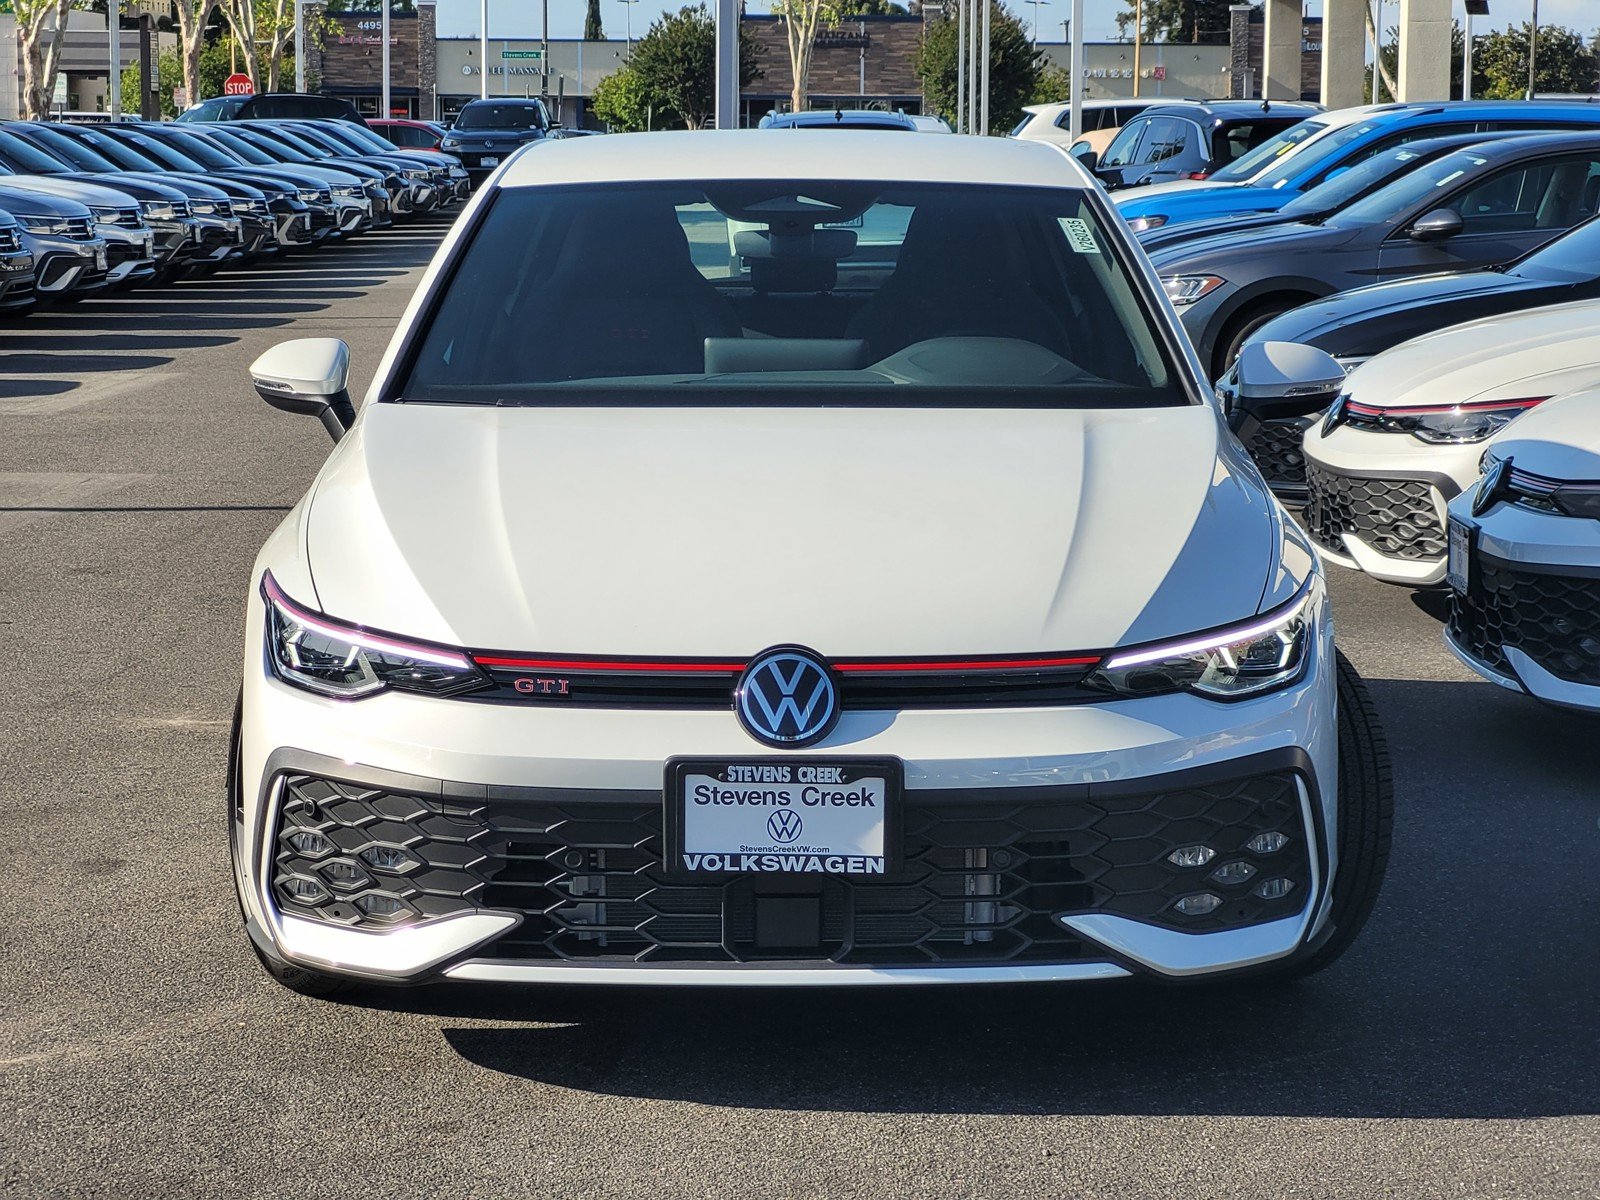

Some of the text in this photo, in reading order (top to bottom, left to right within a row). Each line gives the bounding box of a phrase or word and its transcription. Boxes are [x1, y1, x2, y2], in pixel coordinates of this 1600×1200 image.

[357, 21, 382, 30] 4495
[509, 66, 553, 75] MASSAE
[227, 82, 252, 94] STOP
[513, 677, 570, 694] GTI
[746, 658, 832, 737] VW
[727, 765, 843, 783] STEVENS CREEK
[694, 785, 876, 807] Stevens Creek
[767, 809, 803, 843] VW
[739, 844, 830, 853] StevensCreekVW.com
[682, 854, 884, 874] VOLKSWAGEN
